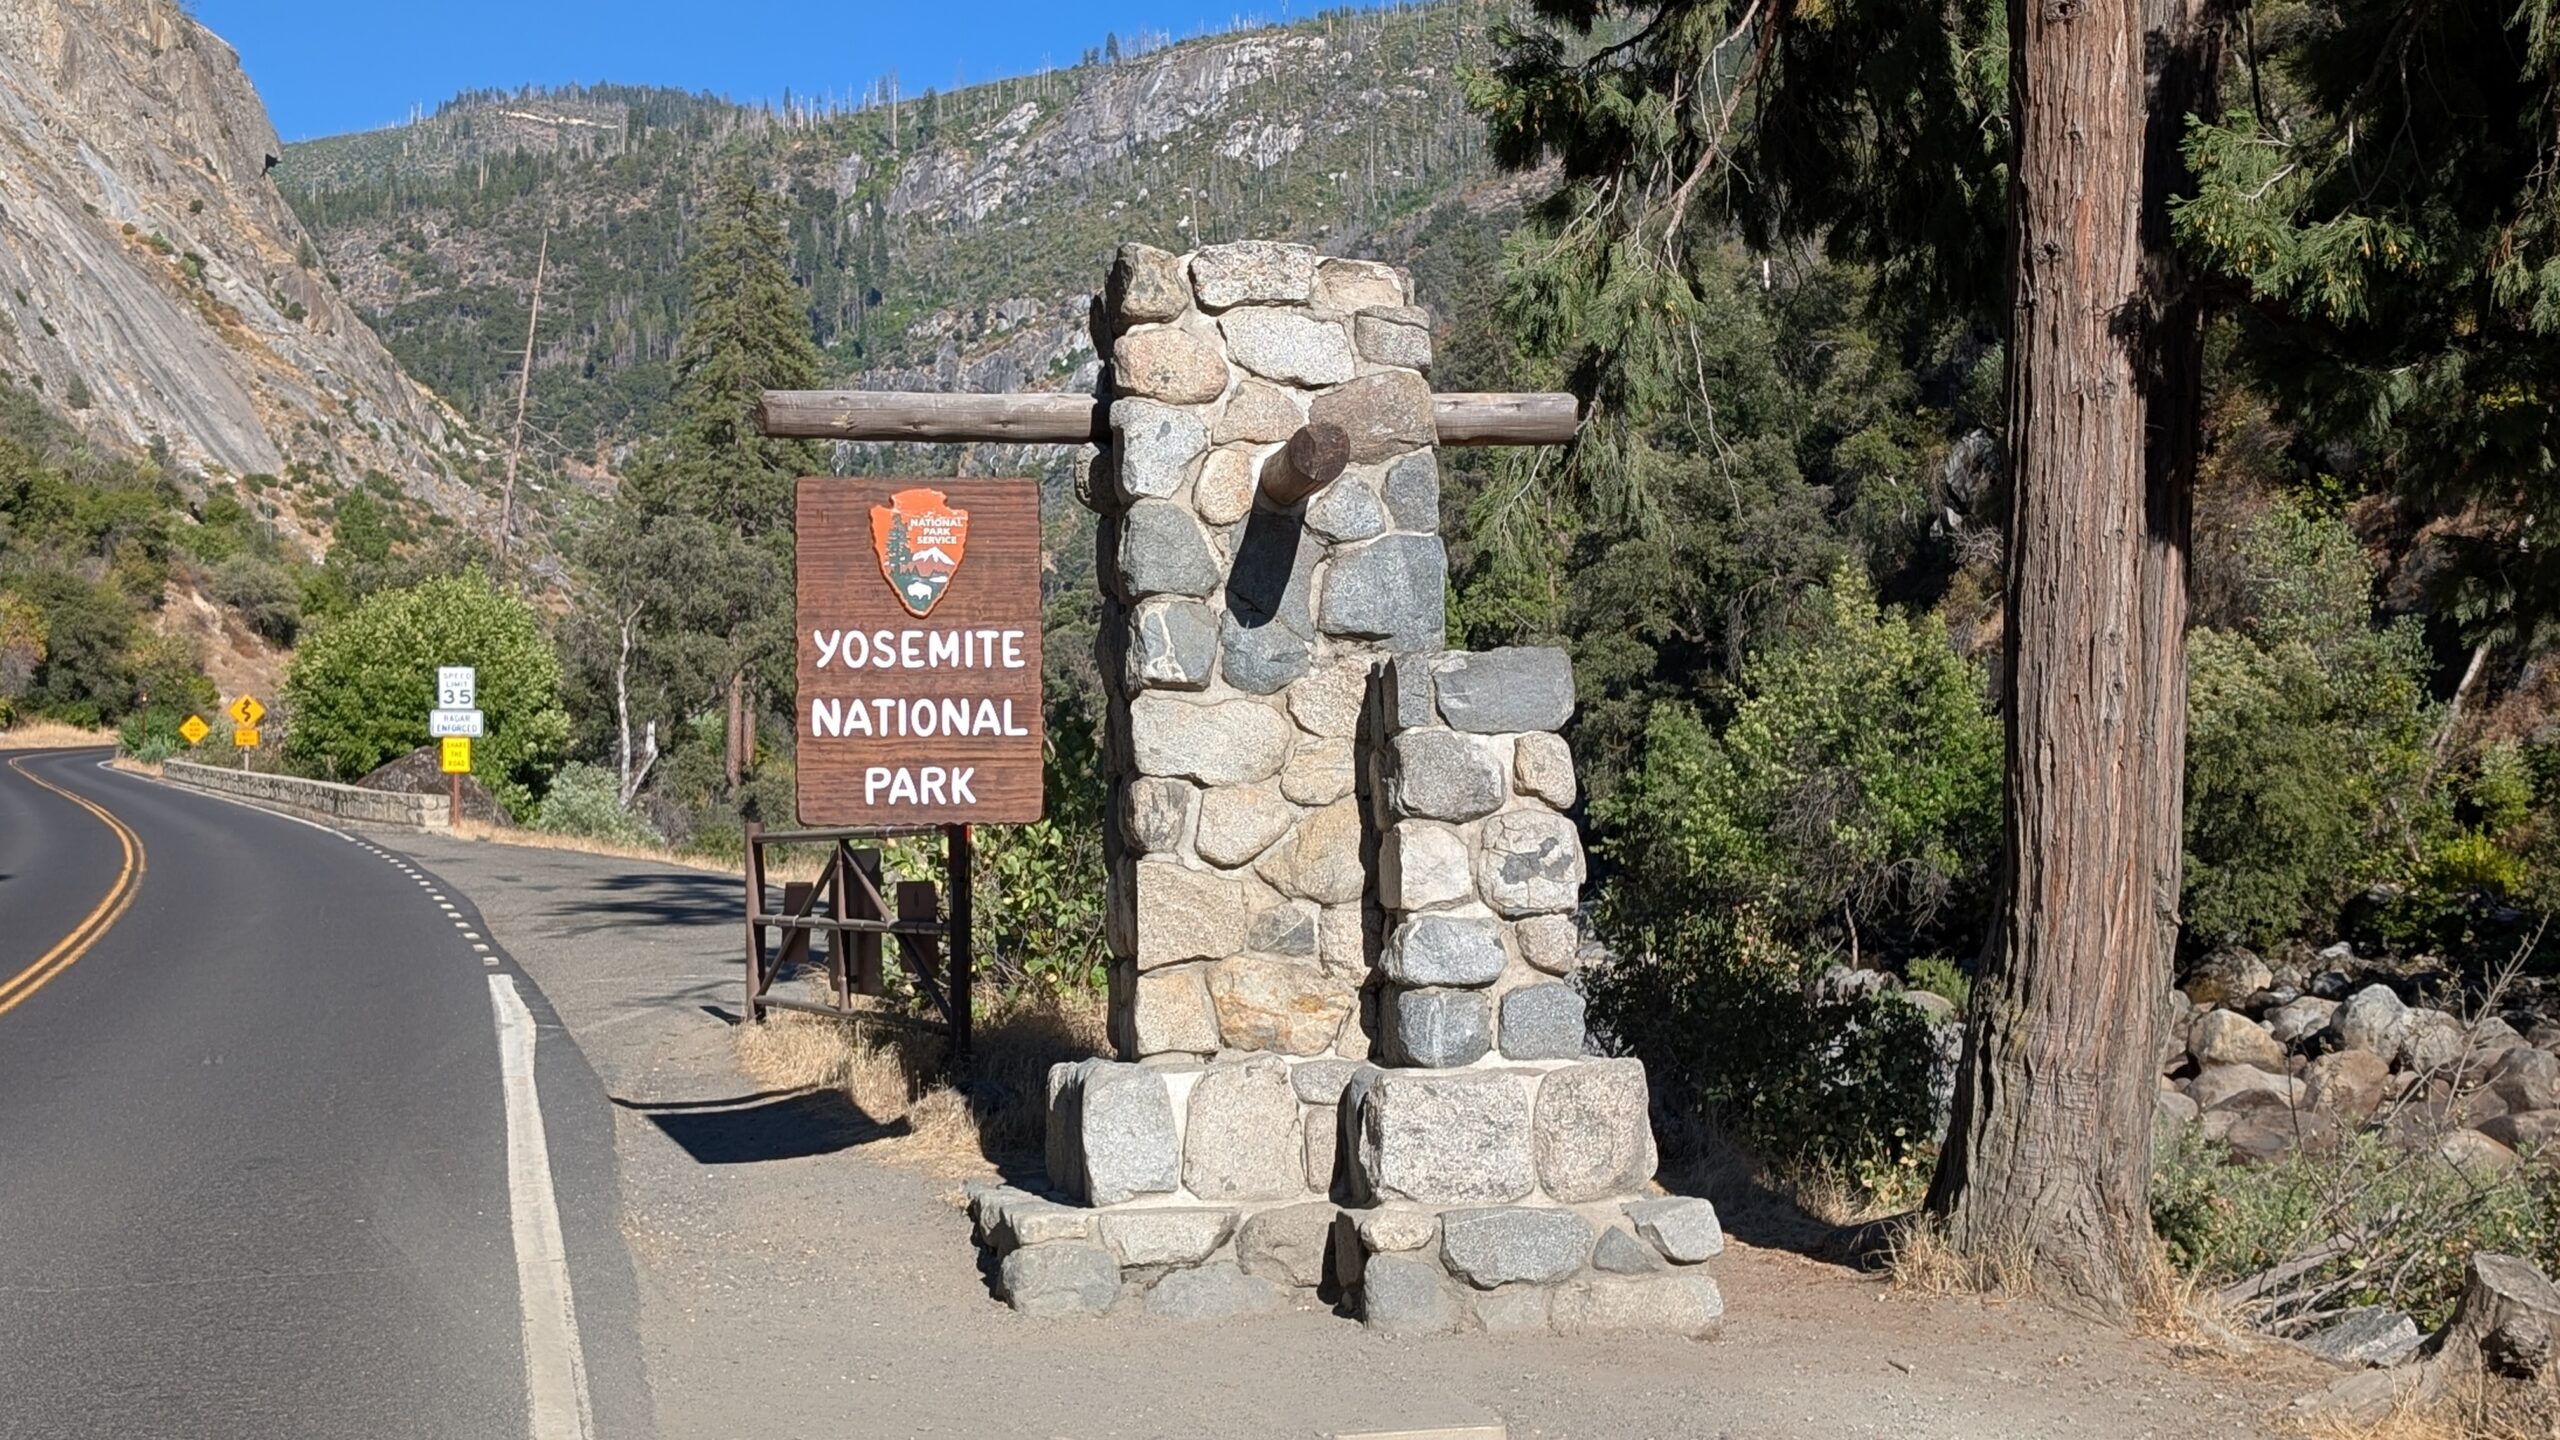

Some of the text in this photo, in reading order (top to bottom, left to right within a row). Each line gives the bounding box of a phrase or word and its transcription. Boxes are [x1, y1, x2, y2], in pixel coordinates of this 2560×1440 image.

[910, 518, 963, 527] NATIONAL
[923, 527, 950, 536] PARK
[917, 536, 957, 545] SERVICE
[813, 629, 1026, 669] YOSEMITE
[443, 689, 472, 704] 35
[444, 714, 471, 722] RADAR
[811, 698, 1028, 737] NATIONAL
[864, 767, 977, 805] PARK
